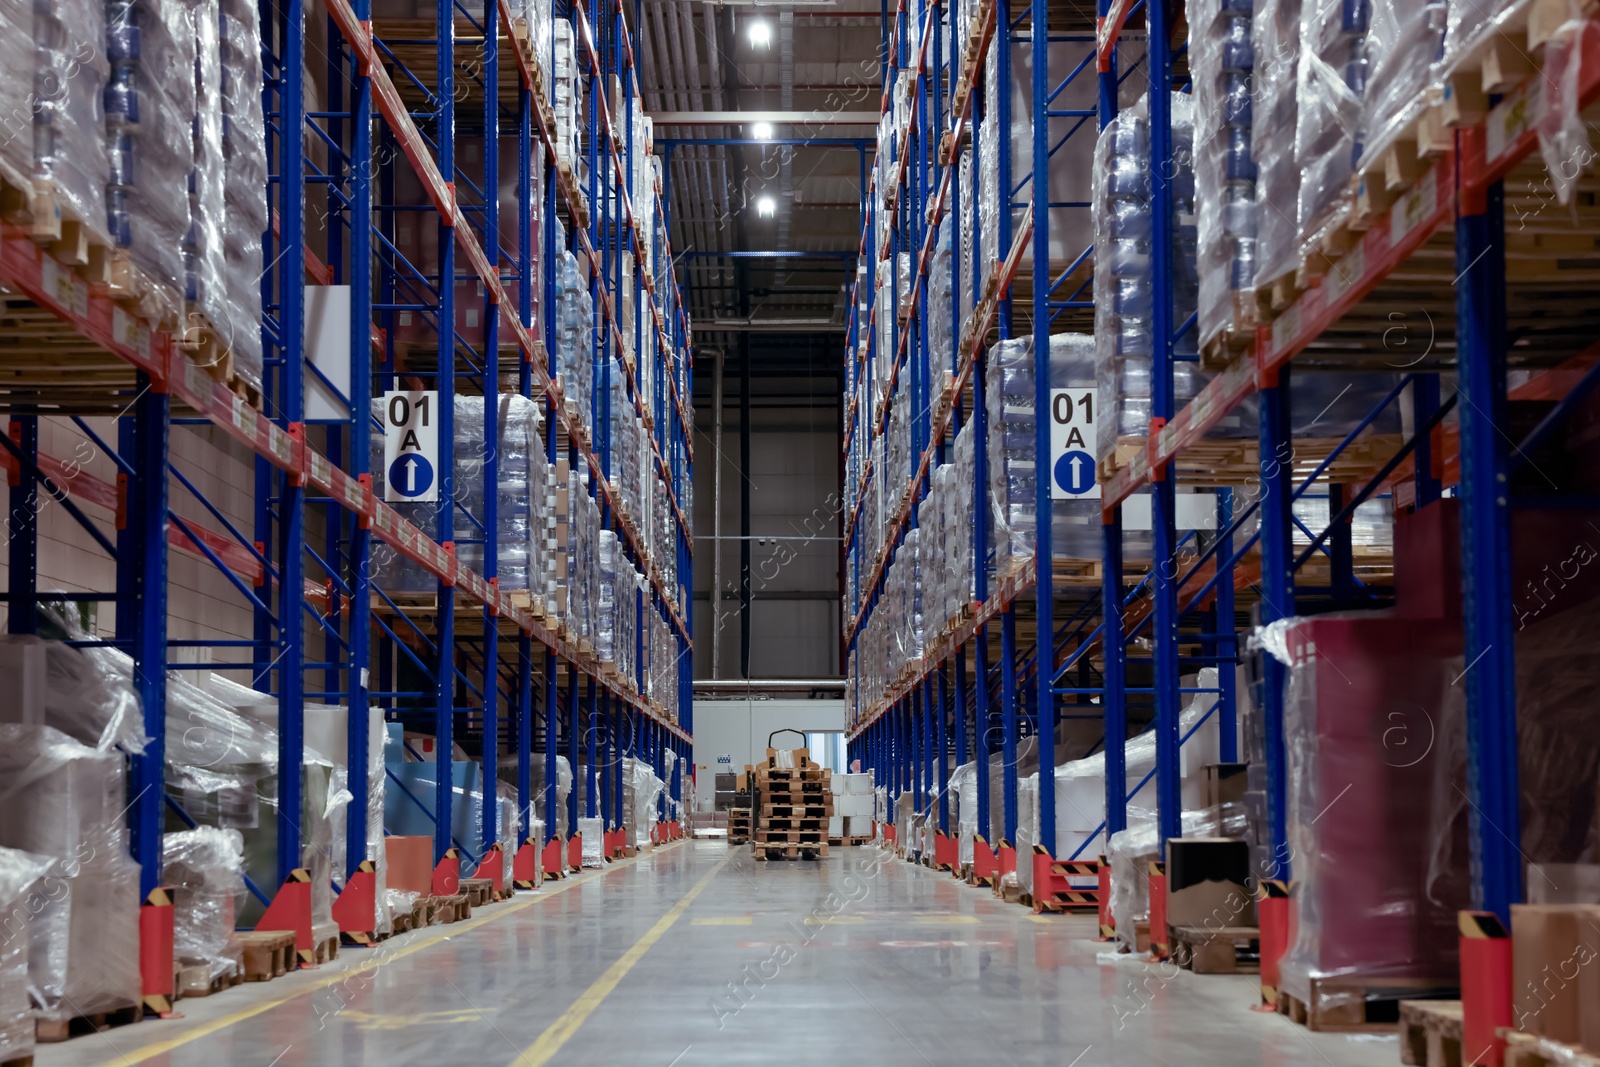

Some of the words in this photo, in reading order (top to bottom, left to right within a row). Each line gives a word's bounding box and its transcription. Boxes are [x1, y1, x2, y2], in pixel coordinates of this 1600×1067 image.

[389, 395, 429, 427] 01
[1053, 393, 1092, 424] 01
[400, 429, 421, 451] A
[1065, 427, 1085, 448] A
